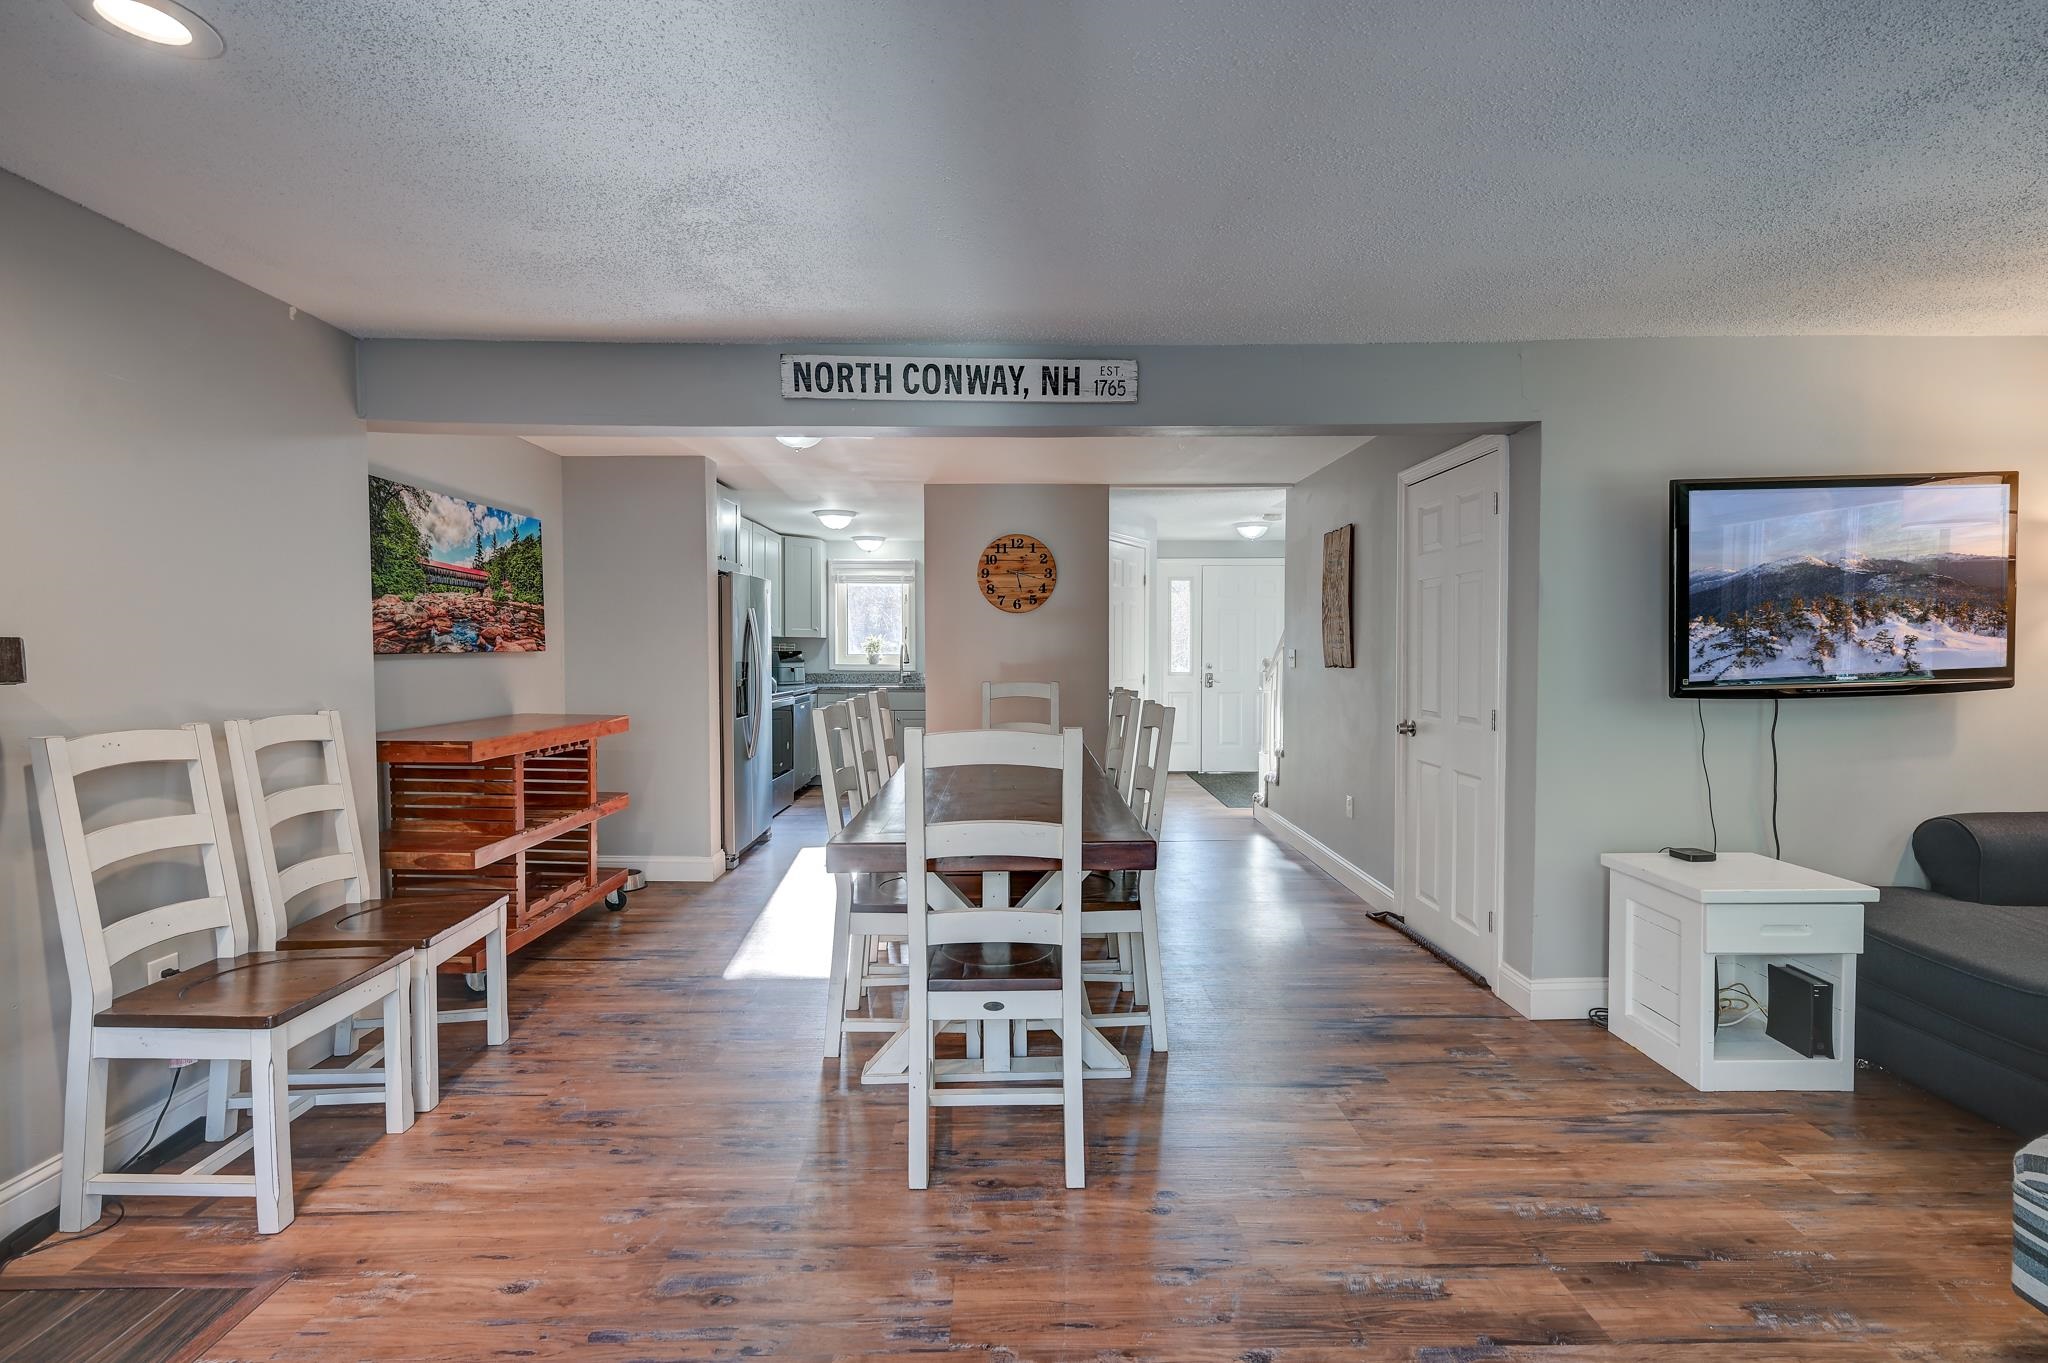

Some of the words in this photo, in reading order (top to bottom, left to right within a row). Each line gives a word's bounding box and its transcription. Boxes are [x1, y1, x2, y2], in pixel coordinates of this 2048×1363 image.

[1100, 365, 1124, 377] EST.
[793, 361, 892, 394] NORTH
[902, 362, 1029, 400] CONWAY,
[1041, 365, 1080, 396] NH
[1094, 379, 1126, 397] 1765
[995, 543, 1008, 554] 11
[1009, 538, 1025, 549] 12
[1029, 542, 1037, 554] 1
[984, 554, 998, 565] 10
[1039, 553, 1048, 564] 2
[981, 568, 990, 579] 9
[1044, 568, 1053, 579] 3
[986, 583, 995, 595] 8
[1038, 583, 1047, 593] 4
[997, 595, 1006, 606] 7
[1012, 599, 1022, 610] 6
[1029, 594, 1038, 605] 5
